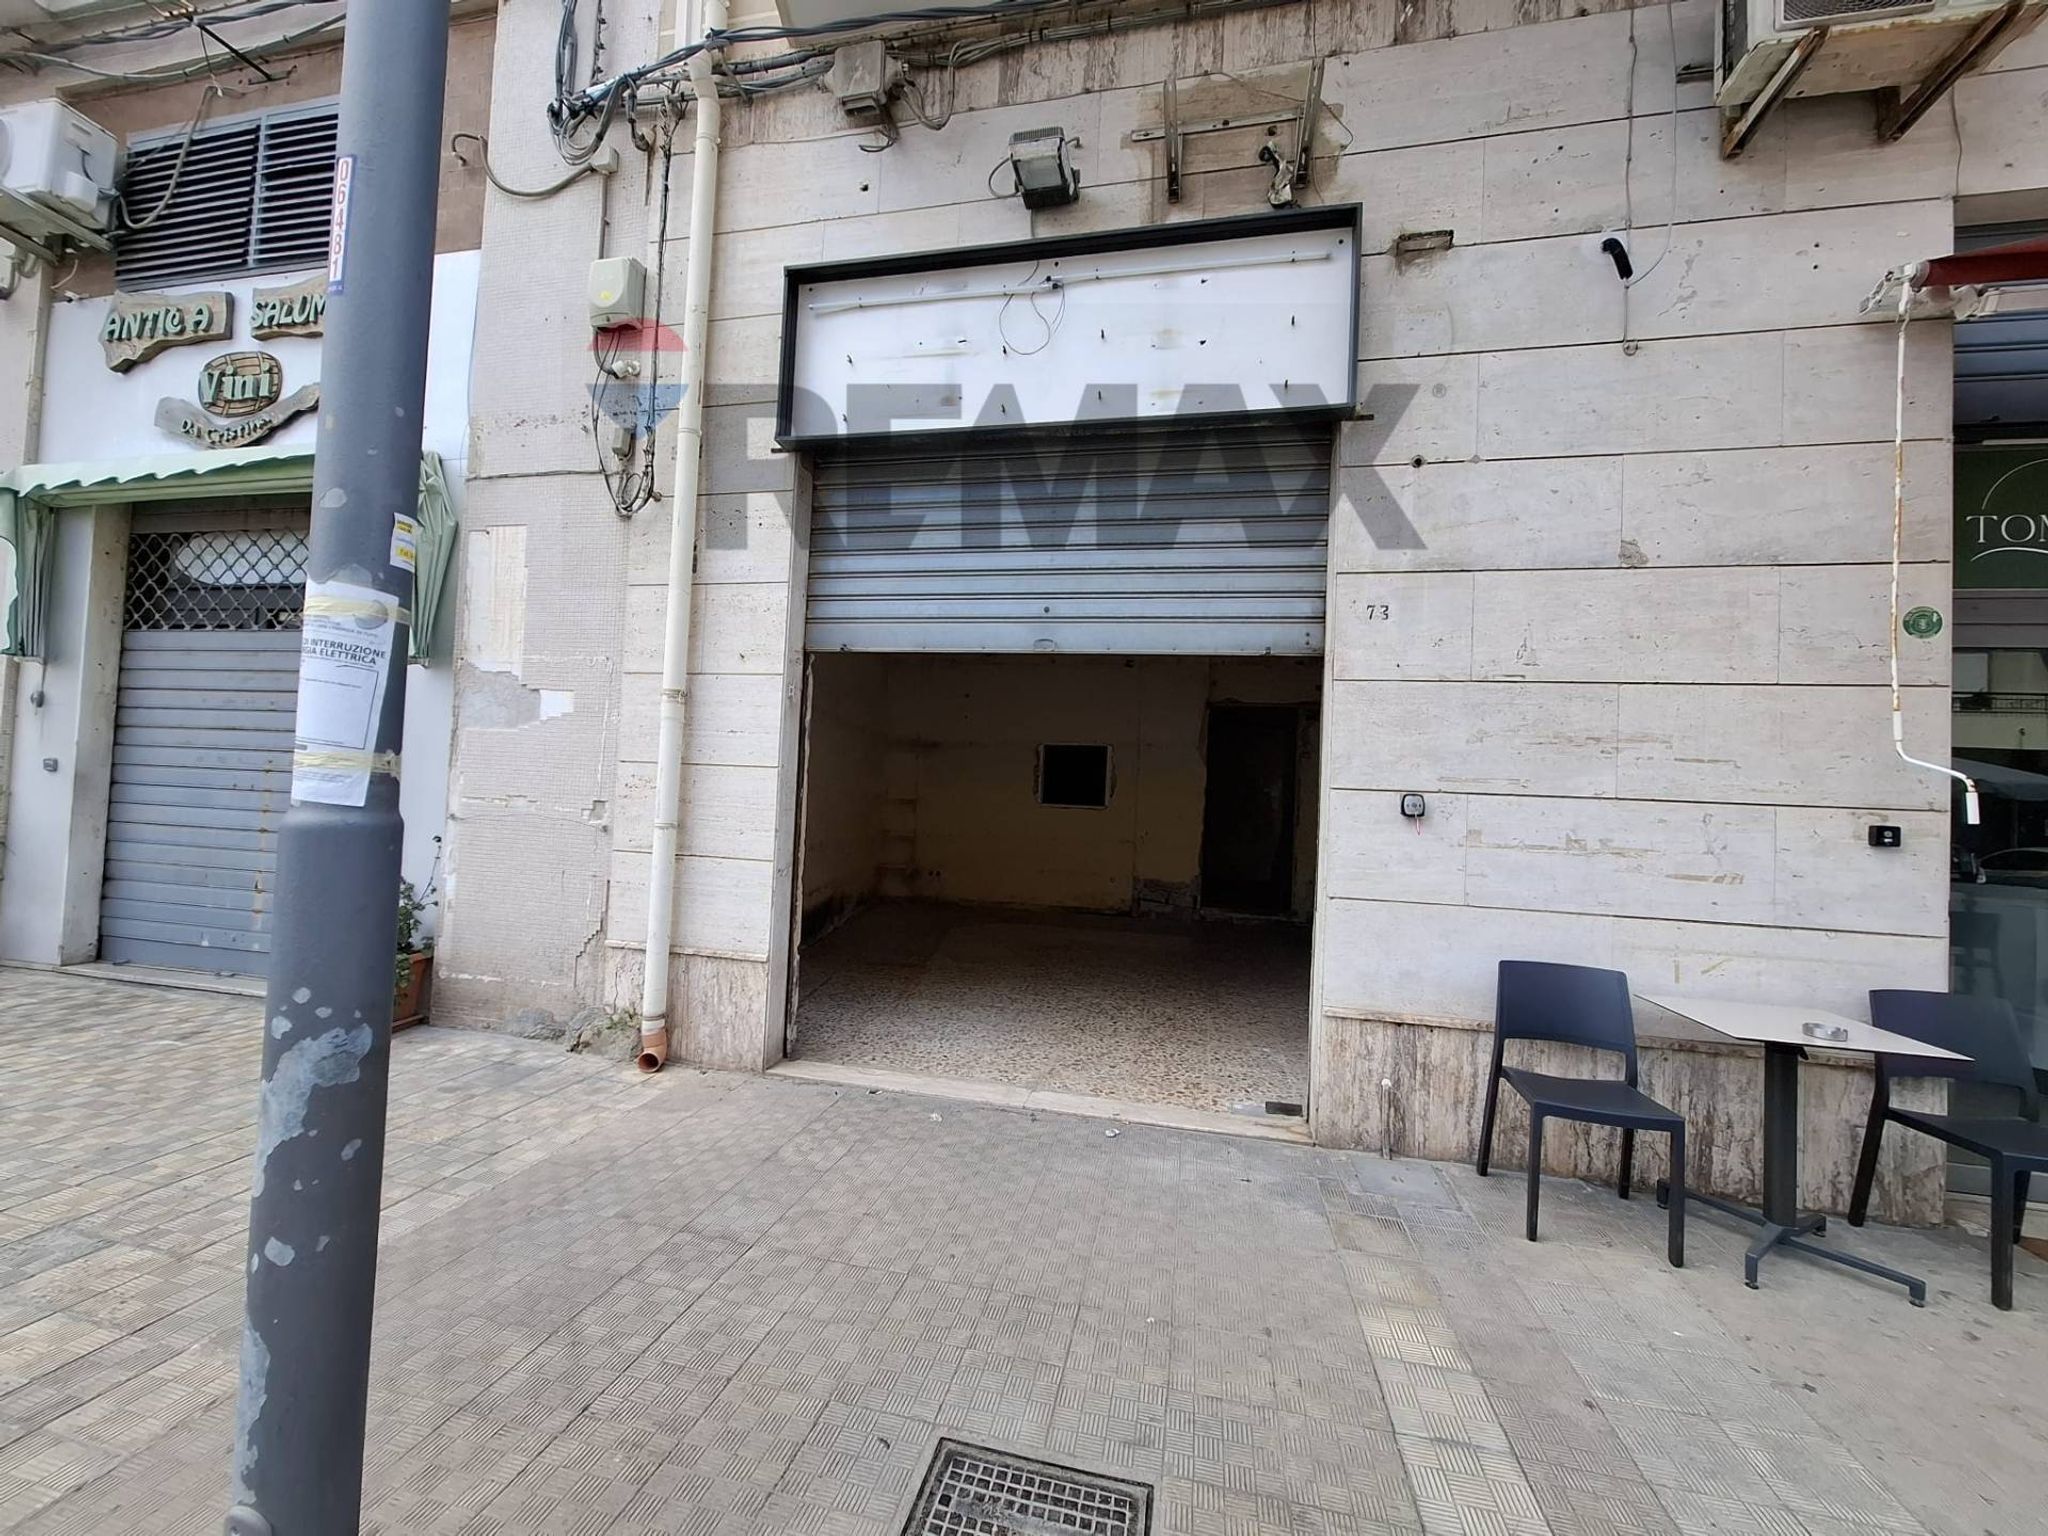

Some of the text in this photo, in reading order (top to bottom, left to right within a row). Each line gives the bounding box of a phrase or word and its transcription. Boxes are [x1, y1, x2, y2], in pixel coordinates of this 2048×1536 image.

[331, 160, 349, 279] 06481
[105, 304, 213, 341] ANTICA
[201, 361, 271, 402] Vini
[1366, 604, 1389, 620] 73
[311, 638, 386, 659] INTERRUZIONE
[320, 647, 377, 666] ELETTRICA
